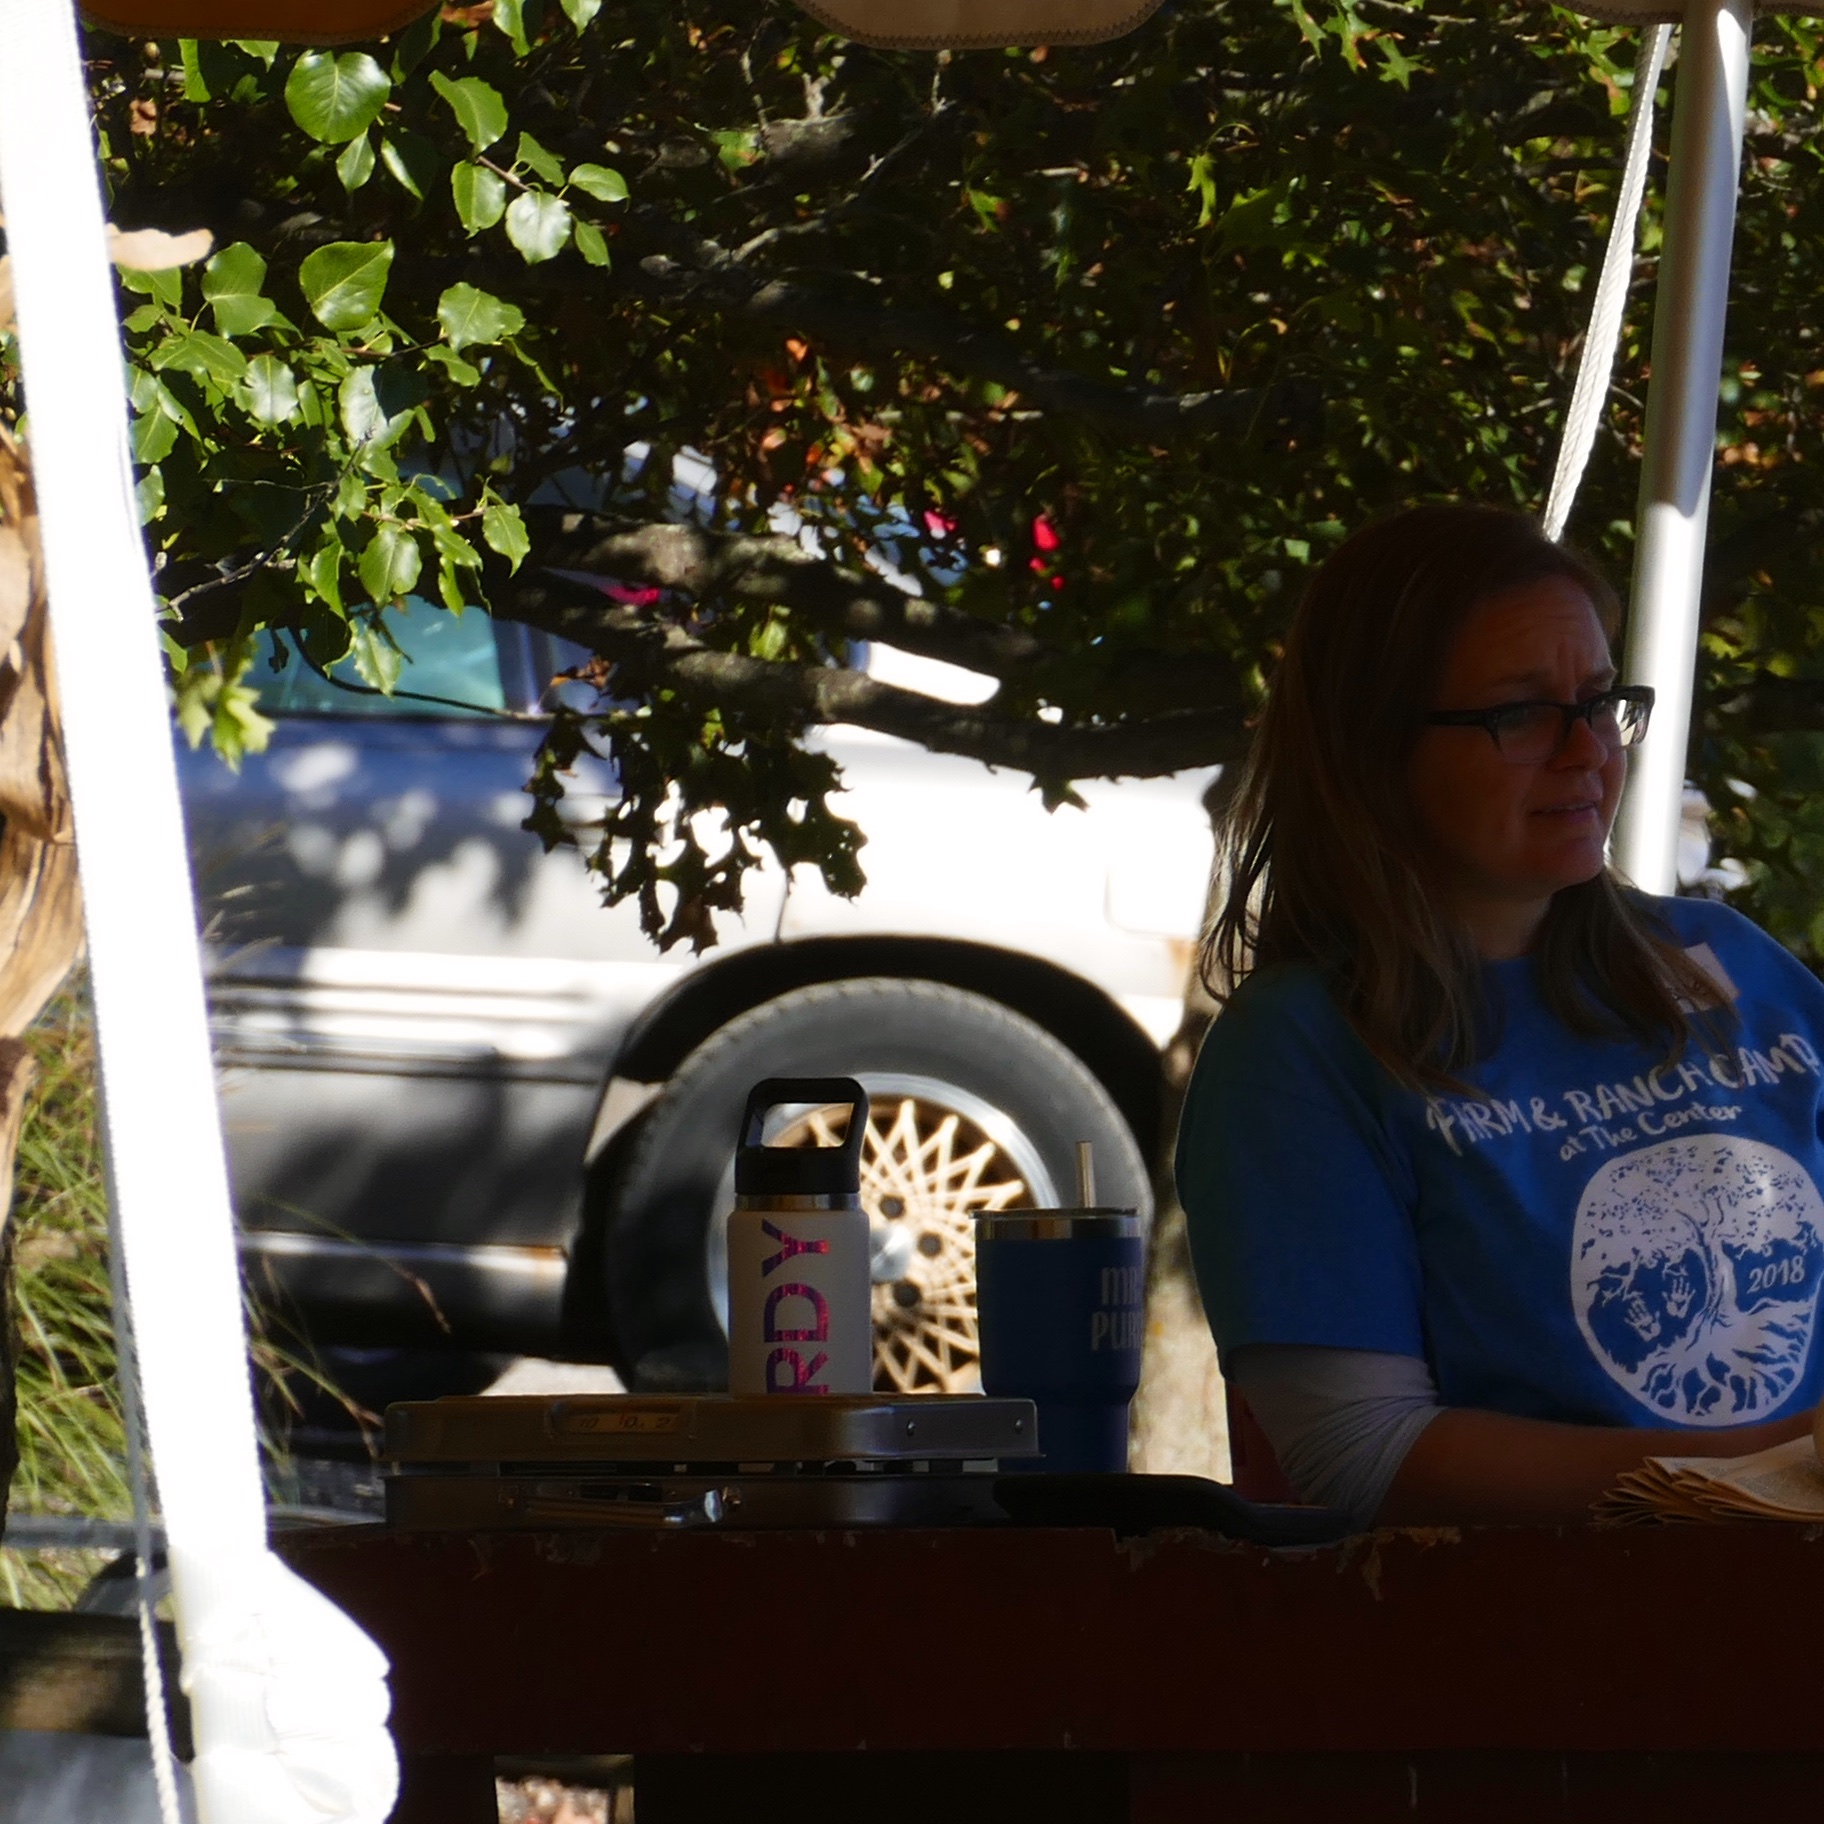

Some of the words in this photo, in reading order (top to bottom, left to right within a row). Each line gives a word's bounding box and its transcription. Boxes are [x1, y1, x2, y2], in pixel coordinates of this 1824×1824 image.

[1530, 1097, 1568, 1131] &
[1563, 1062, 1714, 1123] RANCH
[1709, 1033, 1821, 1088] CAMP
[1559, 1136, 1587, 1161] at
[1578, 1124, 1638, 1149] The
[1637, 1101, 1743, 1135] Center
[1747, 1256, 1806, 1294] 2018
